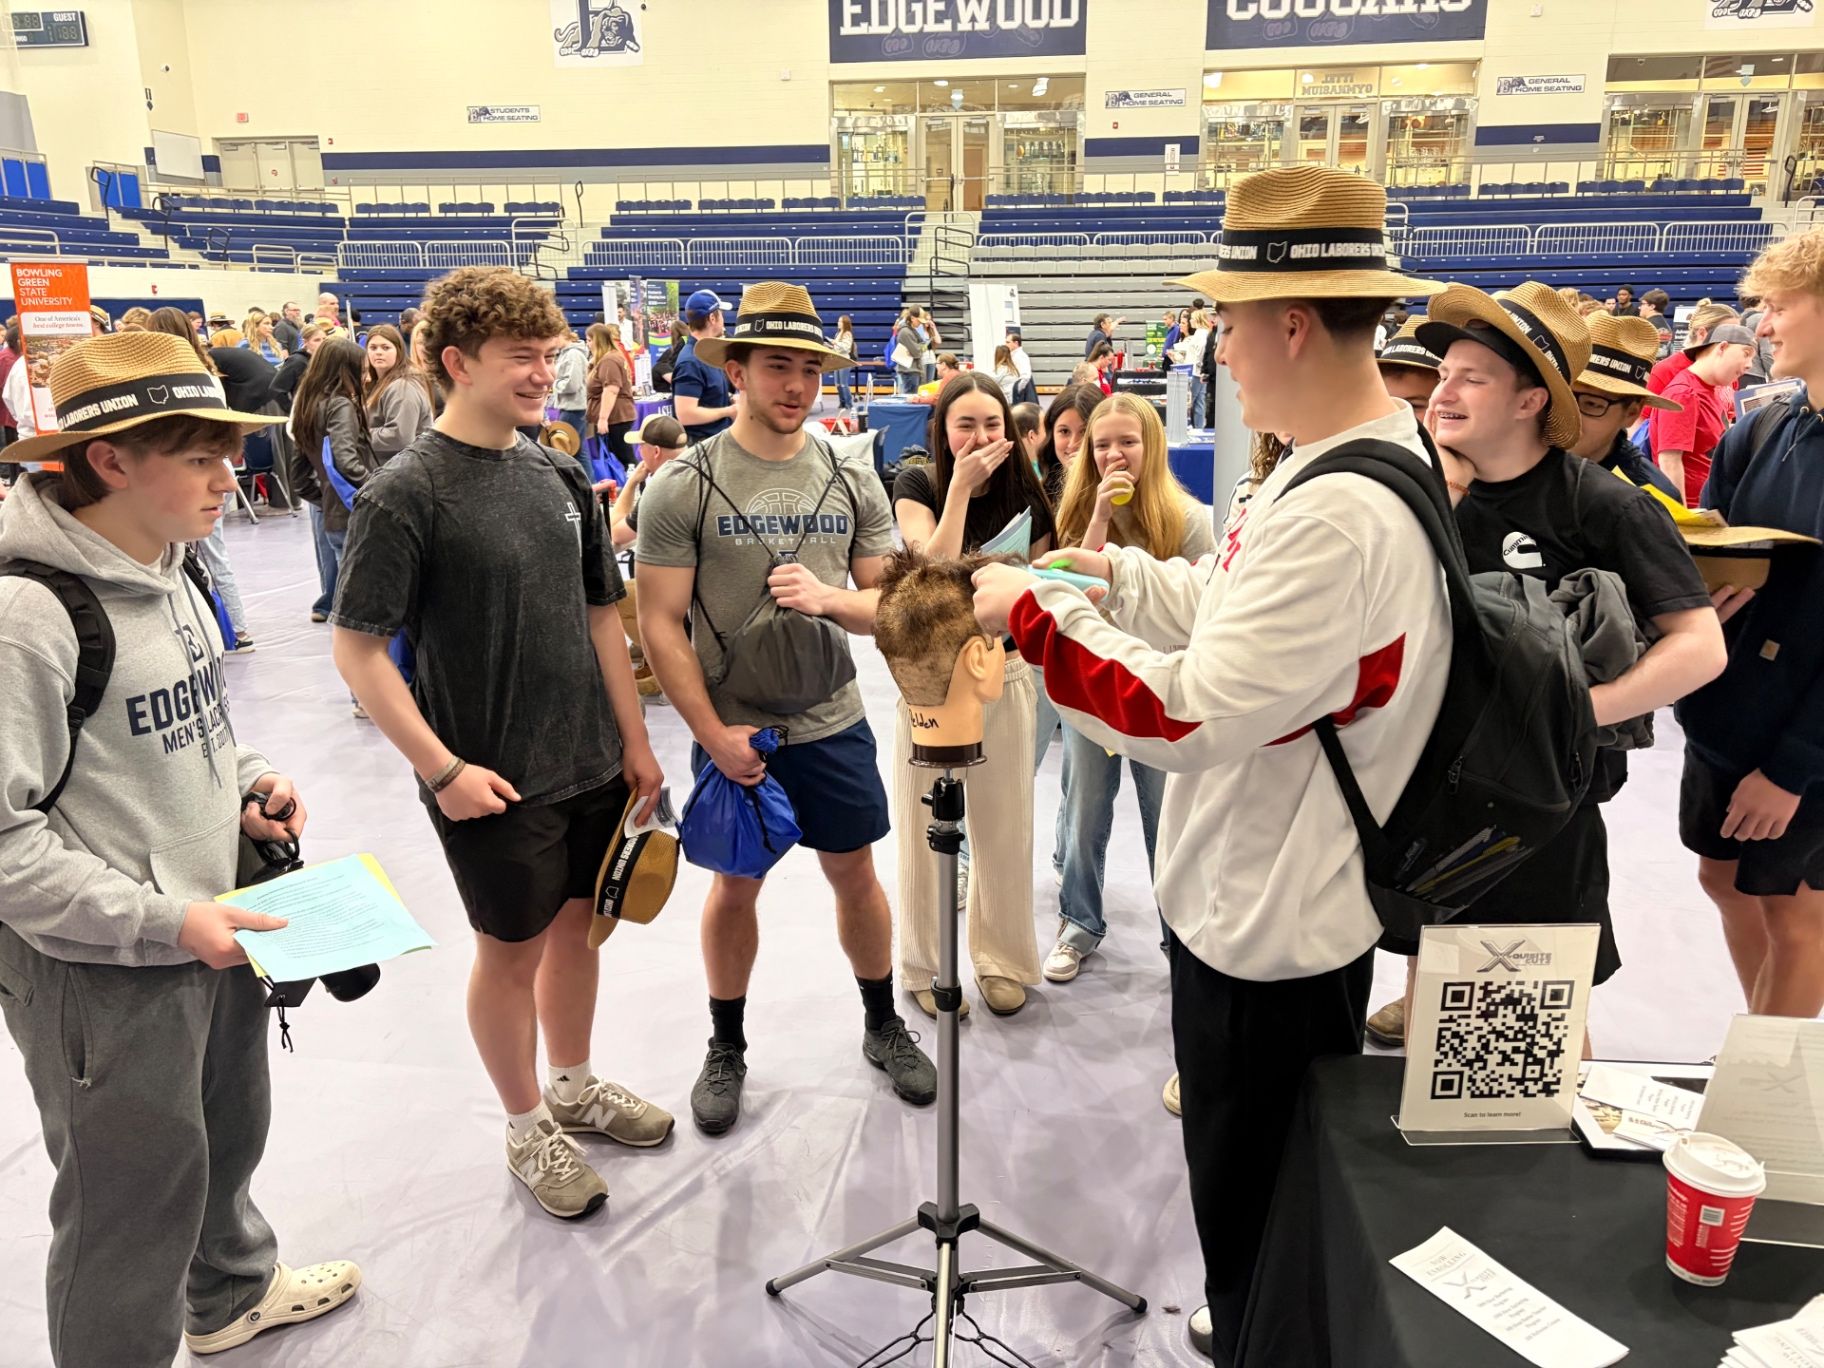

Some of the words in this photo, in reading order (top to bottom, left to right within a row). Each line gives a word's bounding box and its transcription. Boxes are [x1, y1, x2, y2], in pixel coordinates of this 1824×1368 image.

[53, 12, 76, 22] GUEST
[1290, 245, 1320, 259] OHIO
[1320, 243, 1370, 257] LABORERS
[16, 268, 63, 277] BOWLING
[18, 278, 50, 287] GREEN
[19, 288, 47, 296] STATE
[21, 297, 73, 306] UNIVERSITY
[65, 403, 101, 427] LABORERS
[100, 393, 139, 413] UNION
[172, 385, 200, 398] OHIO
[716, 513, 848, 537] EDGEWOOD
[735, 537, 836, 545] BAKETALL
[162, 718, 205, 754] MEN'S
